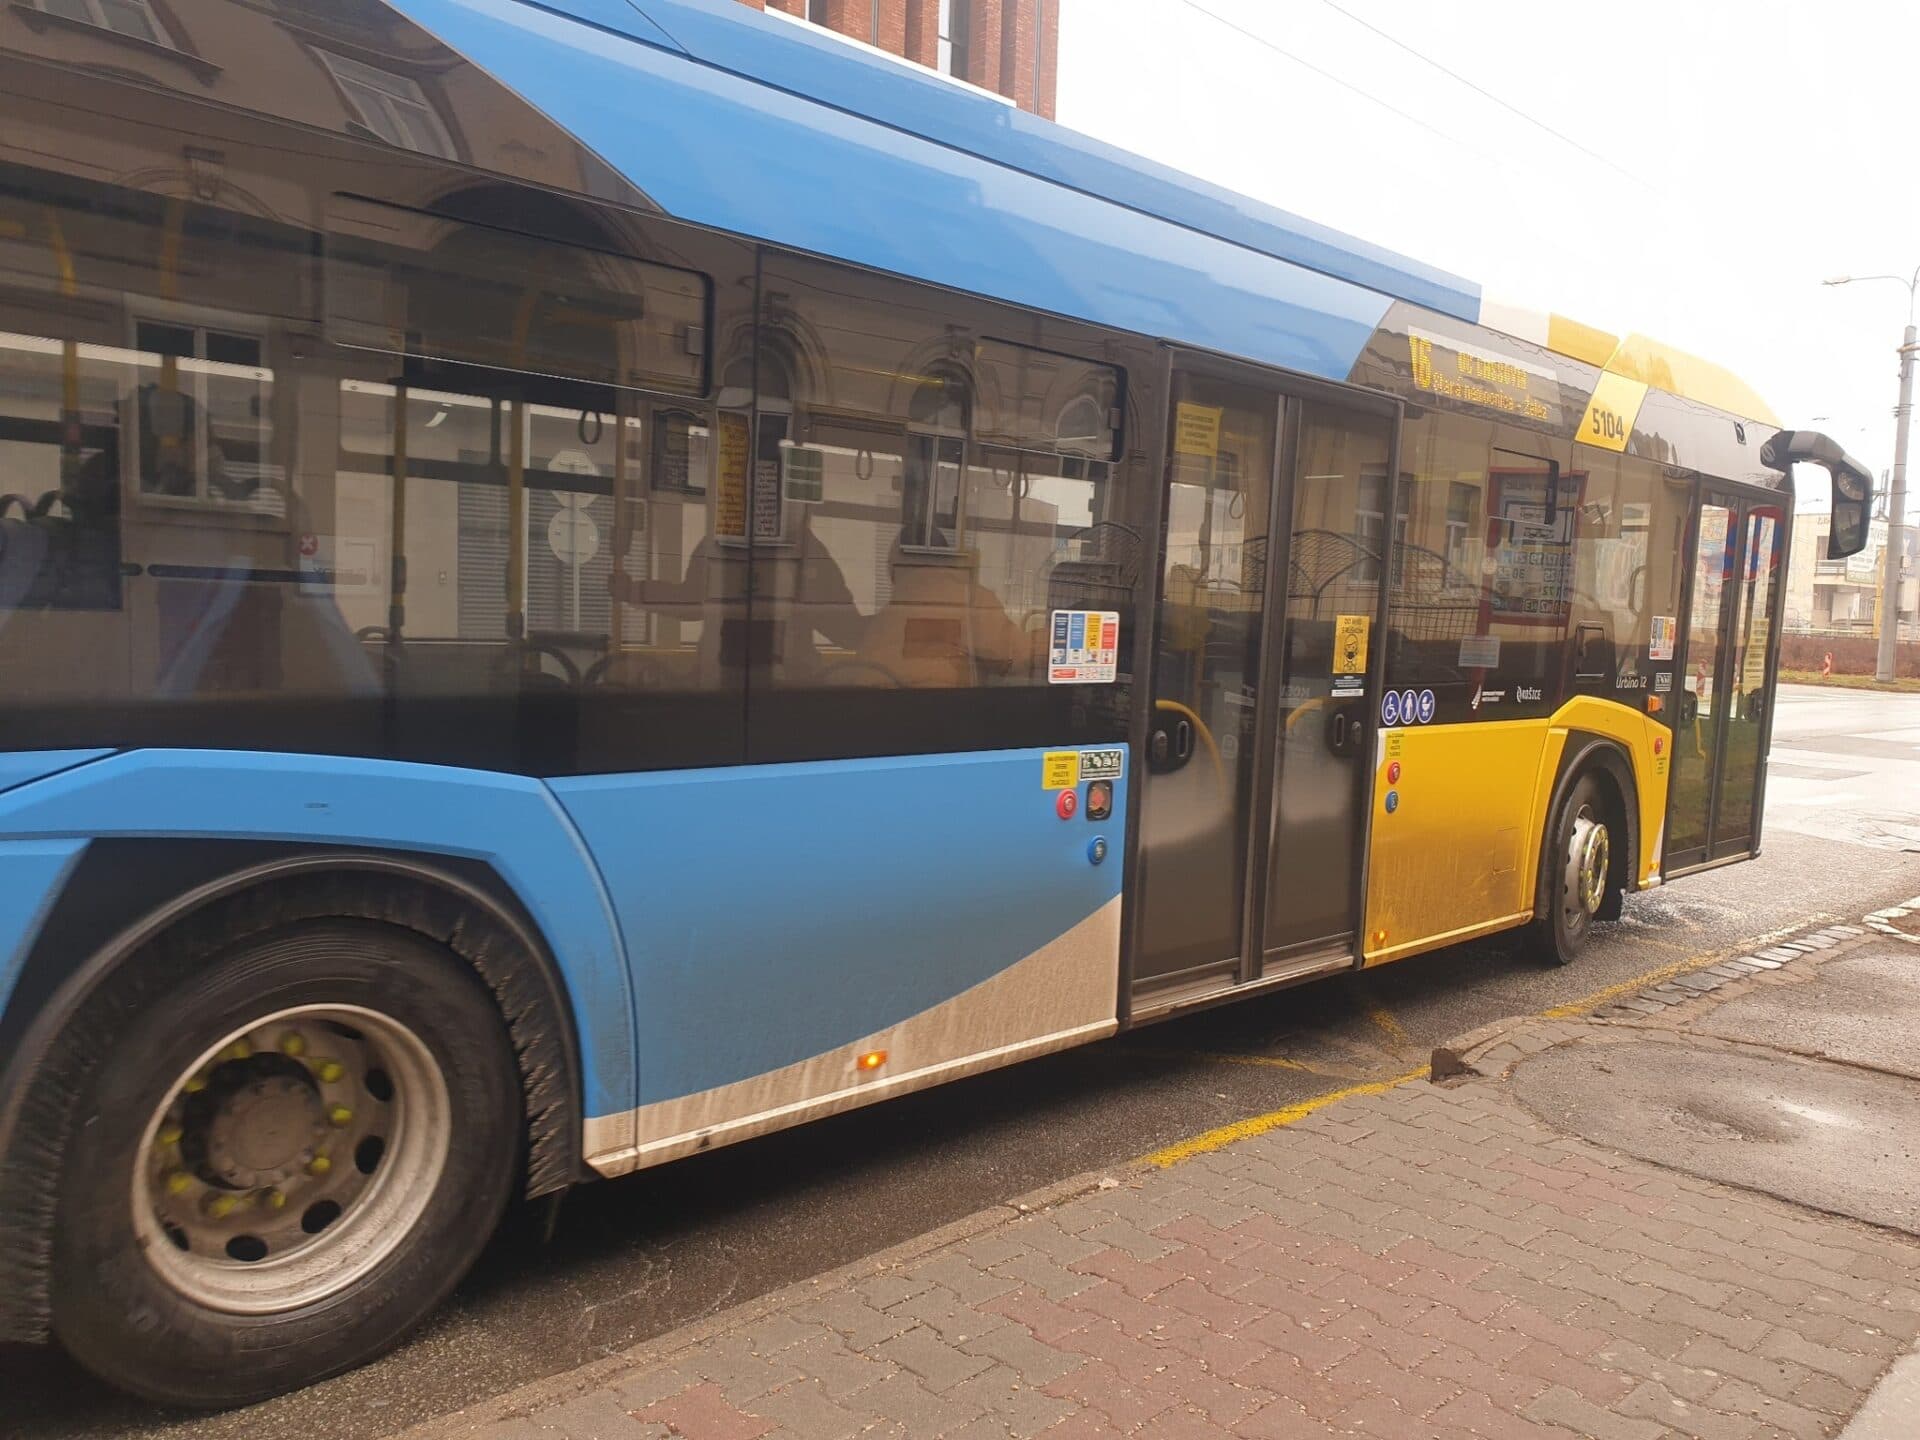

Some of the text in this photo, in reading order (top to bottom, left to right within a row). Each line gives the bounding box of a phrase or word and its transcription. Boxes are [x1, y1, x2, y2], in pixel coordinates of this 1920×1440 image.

[1409, 335, 1431, 389] 16
[1592, 407, 1625, 441] 5104
[1521, 686, 1542, 701] KOŠICE
[1615, 676, 1639, 689] Urbino
[1640, 675, 1648, 688] 12
